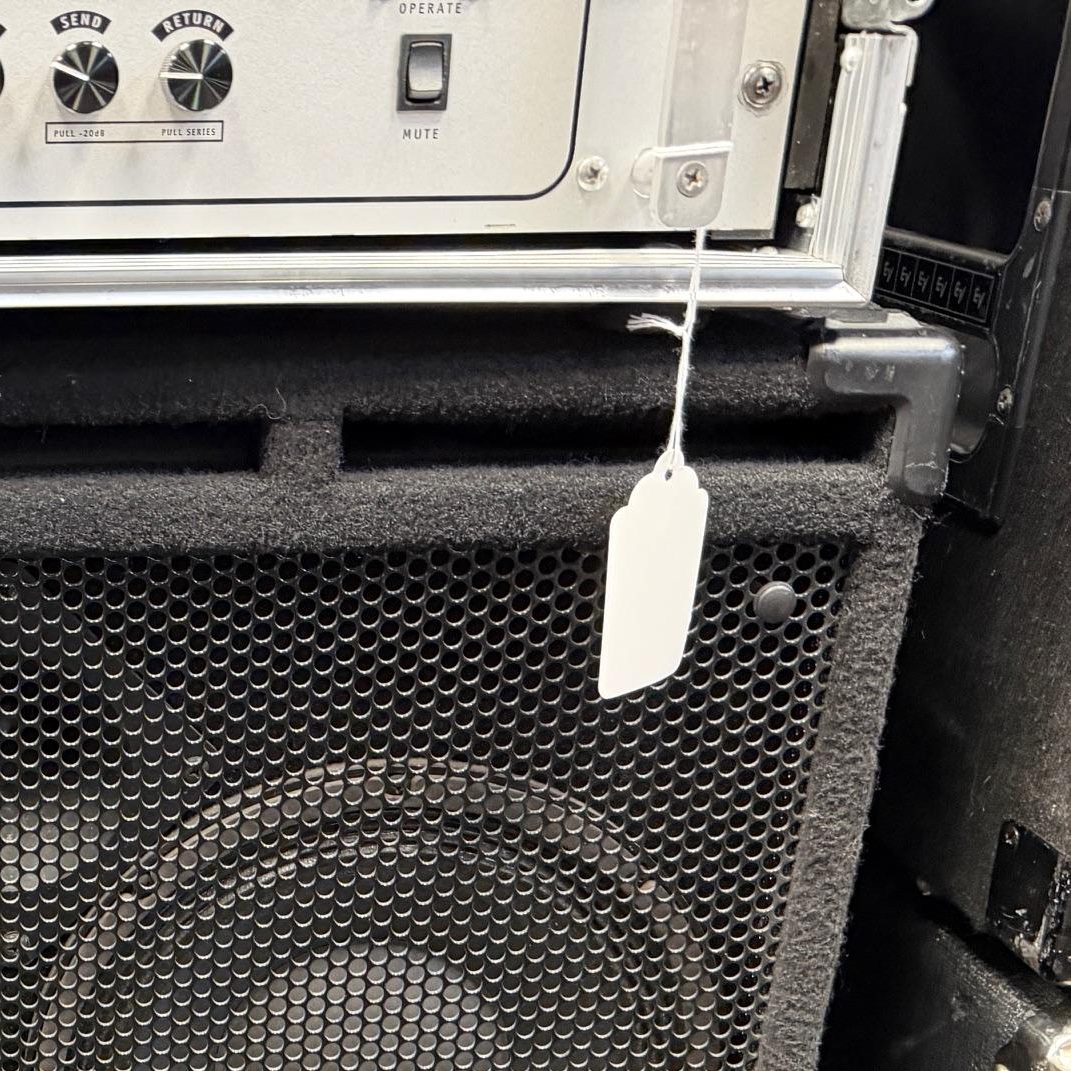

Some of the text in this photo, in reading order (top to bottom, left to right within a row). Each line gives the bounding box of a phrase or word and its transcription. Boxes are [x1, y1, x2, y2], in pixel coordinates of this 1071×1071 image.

[398, 2, 463, 14] OPERATE
[59, 12, 102, 29] SEND
[162, 12, 225, 33] RETURN
[53, 129, 76, 138] PULL
[161, 127, 217, 137] PULL SERIES
[402, 128, 440, 140] MUTE
